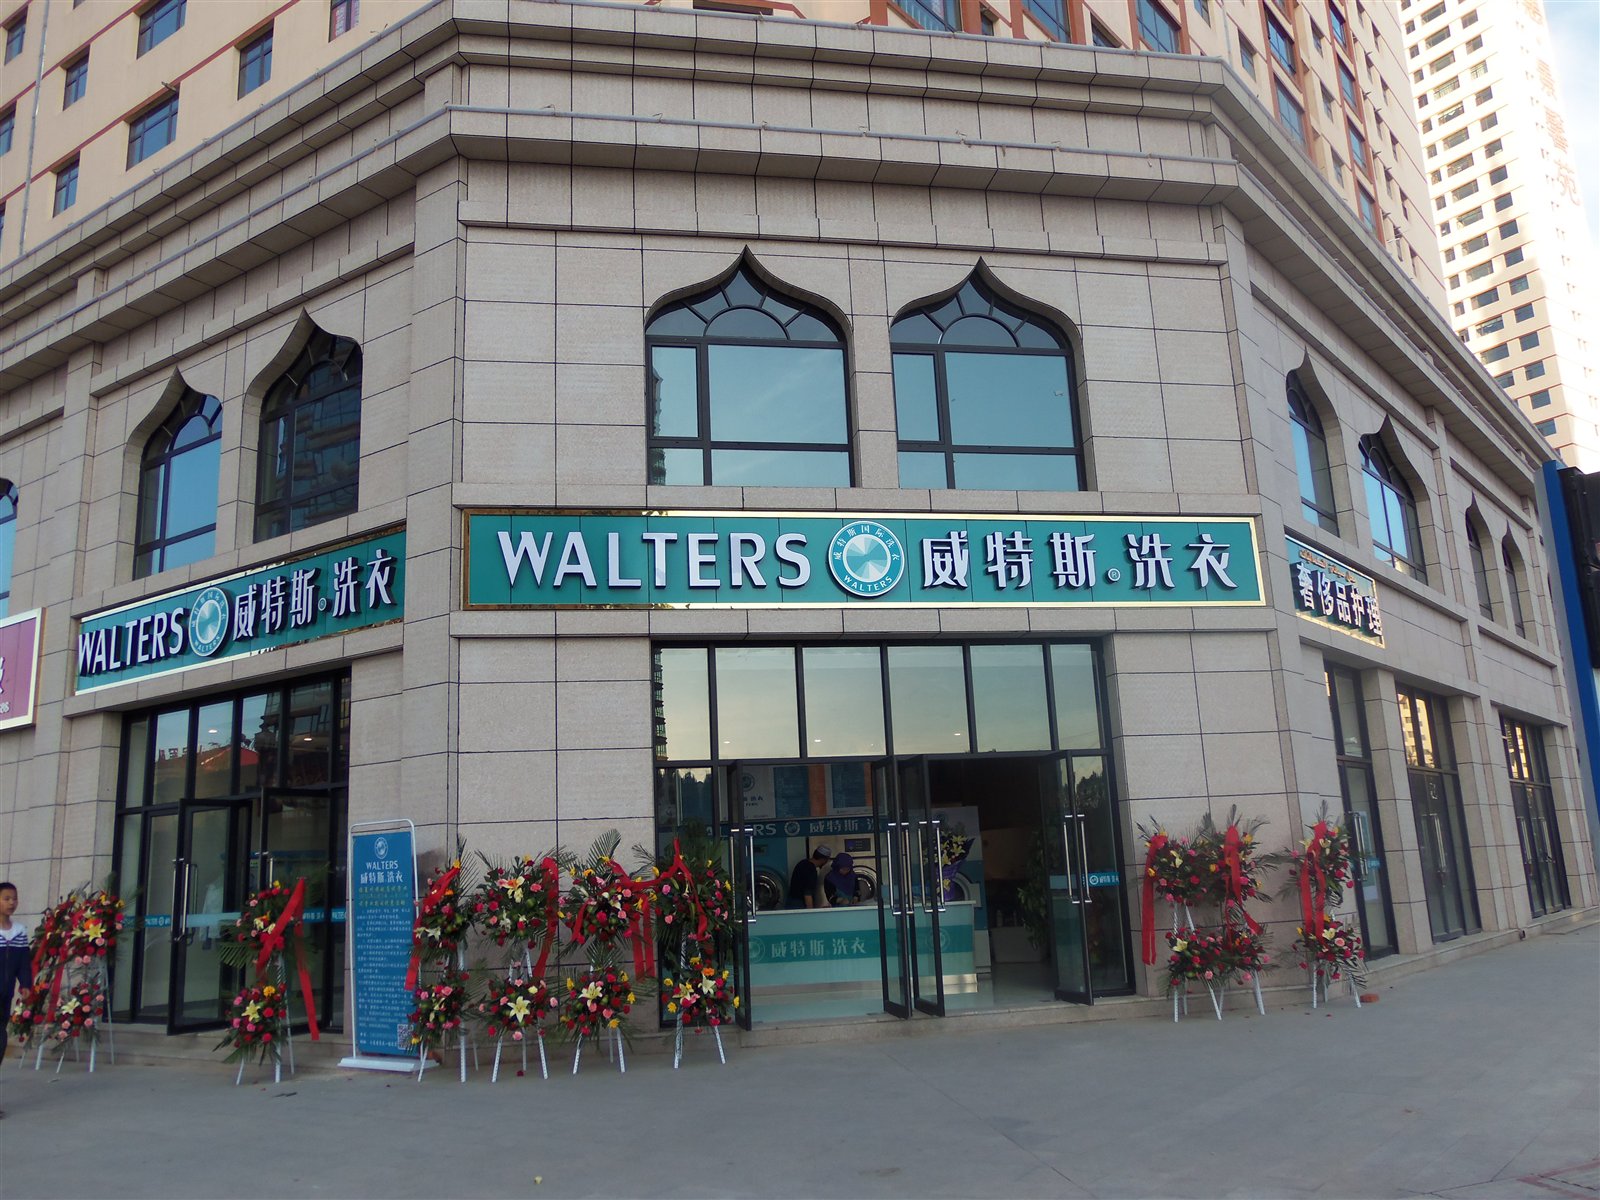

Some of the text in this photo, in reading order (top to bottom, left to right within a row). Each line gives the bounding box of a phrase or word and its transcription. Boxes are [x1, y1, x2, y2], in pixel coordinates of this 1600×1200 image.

[498, 531, 811, 588] WALTERS
[844, 575, 893, 592] WALTERS
[1296, 561, 1382, 636] 奢侈品护理
[79, 607, 184, 676] WALTERS
[365, 860, 399, 871] WALTERS
